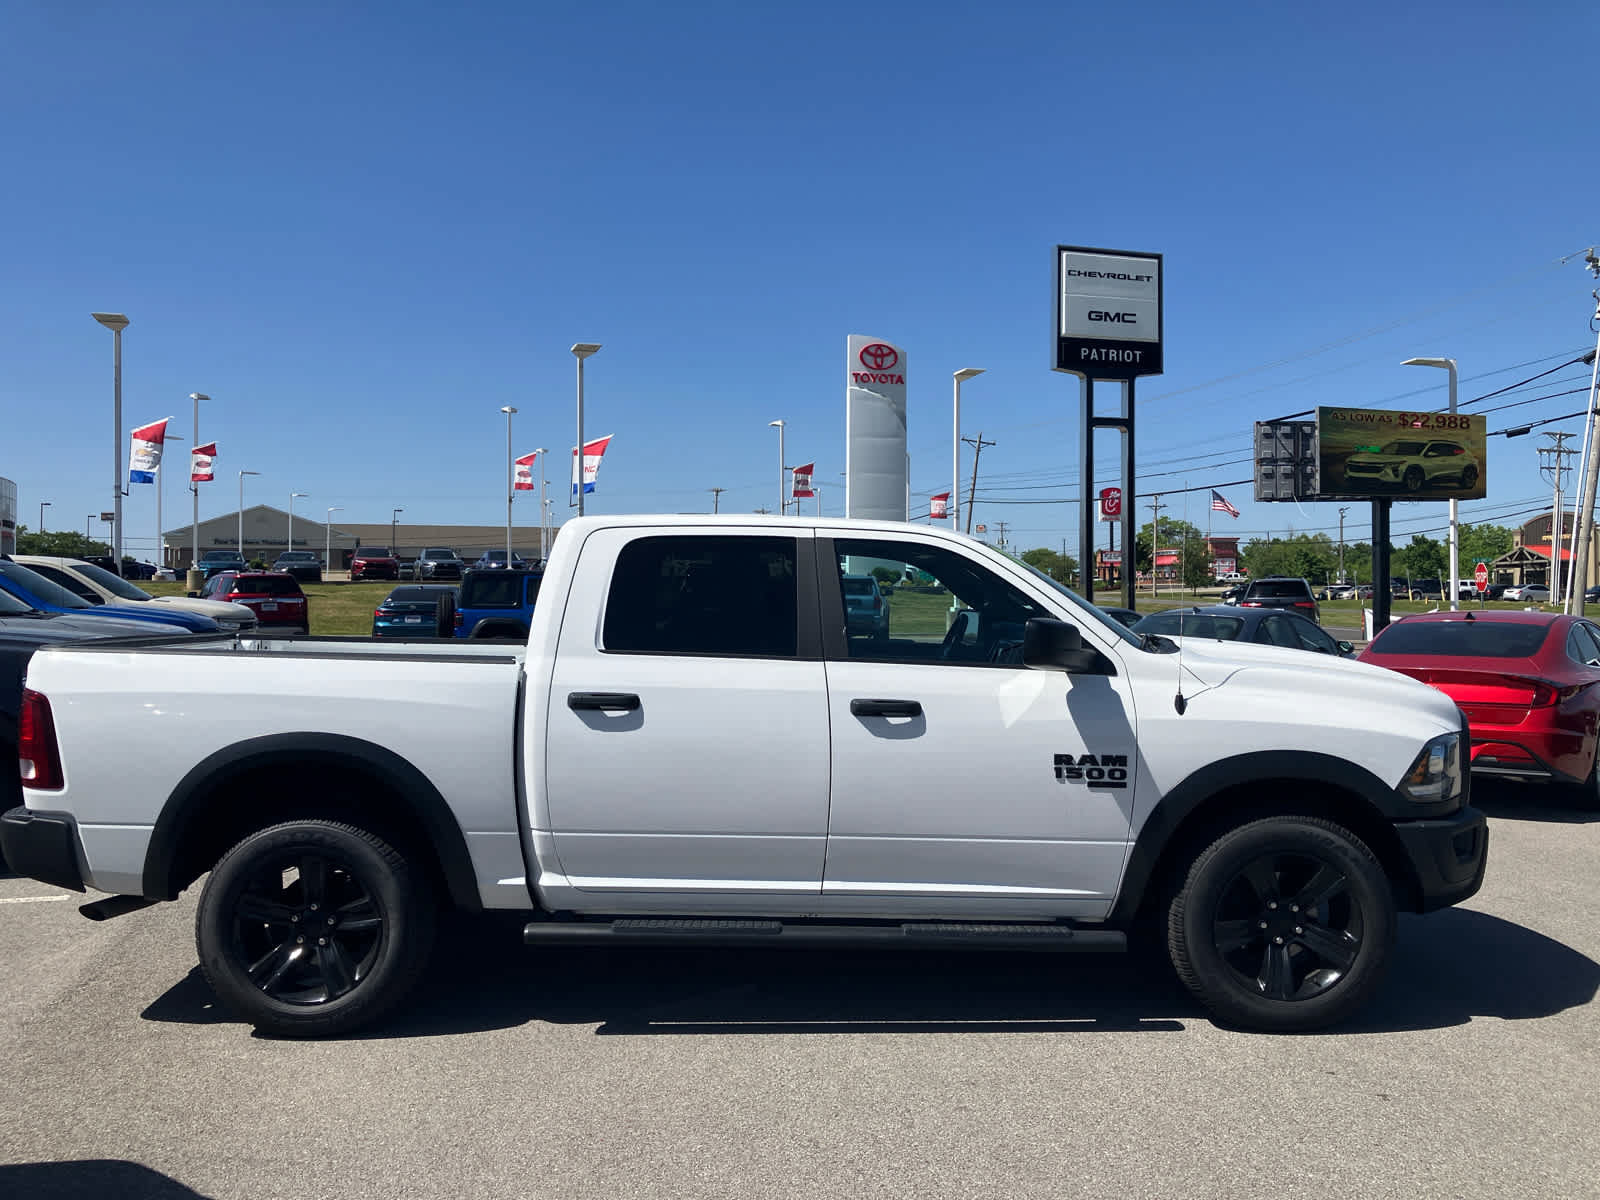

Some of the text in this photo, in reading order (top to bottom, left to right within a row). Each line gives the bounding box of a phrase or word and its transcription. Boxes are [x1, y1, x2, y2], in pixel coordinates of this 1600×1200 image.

[1067, 269, 1153, 282] CHEVROLET
[1088, 310, 1136, 324] GMC
[1080, 347, 1142, 363] PATRIOT
[852, 371, 905, 384] TOYOTA
[1331, 411, 1471, 431] AS LOW AS $22,988
[1053, 753, 1128, 767] RAM
[1053, 766, 1128, 781] 1500
